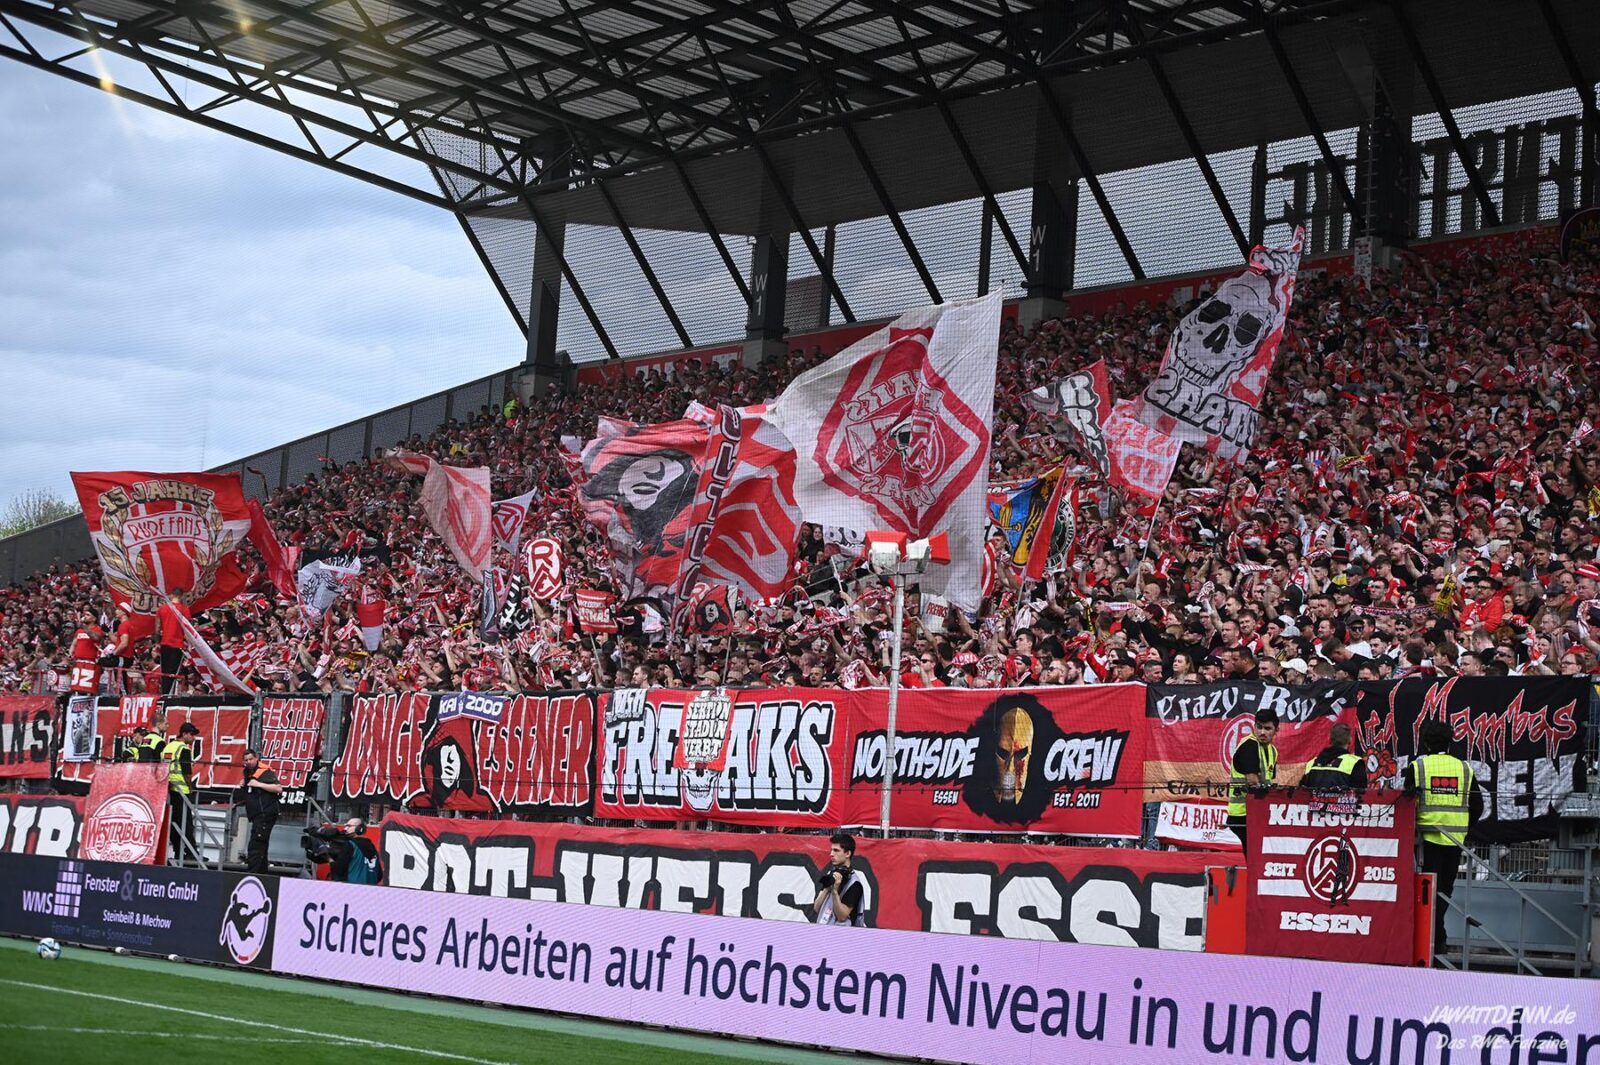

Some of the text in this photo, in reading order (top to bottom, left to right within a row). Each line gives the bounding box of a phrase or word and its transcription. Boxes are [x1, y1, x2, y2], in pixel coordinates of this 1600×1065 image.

[1031, 226, 1045, 244] W
[755, 273, 767, 292] W
[99, 480, 216, 515] 15 JAHRE
[128, 516, 202, 542] RUDE FANS
[121, 697, 154, 724] RVT
[439, 695, 503, 716] KAI 2000
[1413, 676, 1577, 766] Mambas
[332, 692, 432, 799] JUNGE
[477, 694, 594, 807] ESSENER
[601, 700, 832, 812] FREAKS
[851, 734, 1123, 783] NORTHSIDE CREW
[932, 789, 1101, 808] ESSEN EST. 2011
[1171, 805, 1189, 828] LA
[1269, 804, 1395, 828] KATEGORIE
[384, 830, 872, 925] ROT-WEIS
[1264, 862, 1395, 881] SEIT 2015
[85, 874, 120, 893] Fenster
[138, 878, 165, 898] Türen
[168, 882, 199, 901] GmbH
[23, 890, 53, 914] WMS
[1280, 911, 1372, 935] ESSEN
[300, 901, 426, 963] Sicheres
[436, 917, 592, 983] Arbeiten
[605, 935, 672, 992] auf
[684, 938, 907, 1020] höchstem
[926, 963, 1105, 1041] Niveau
[1128, 978, 1178, 1049] in
[1204, 992, 1322, 1065] und
[1346, 1015, 1451, 1065] um
